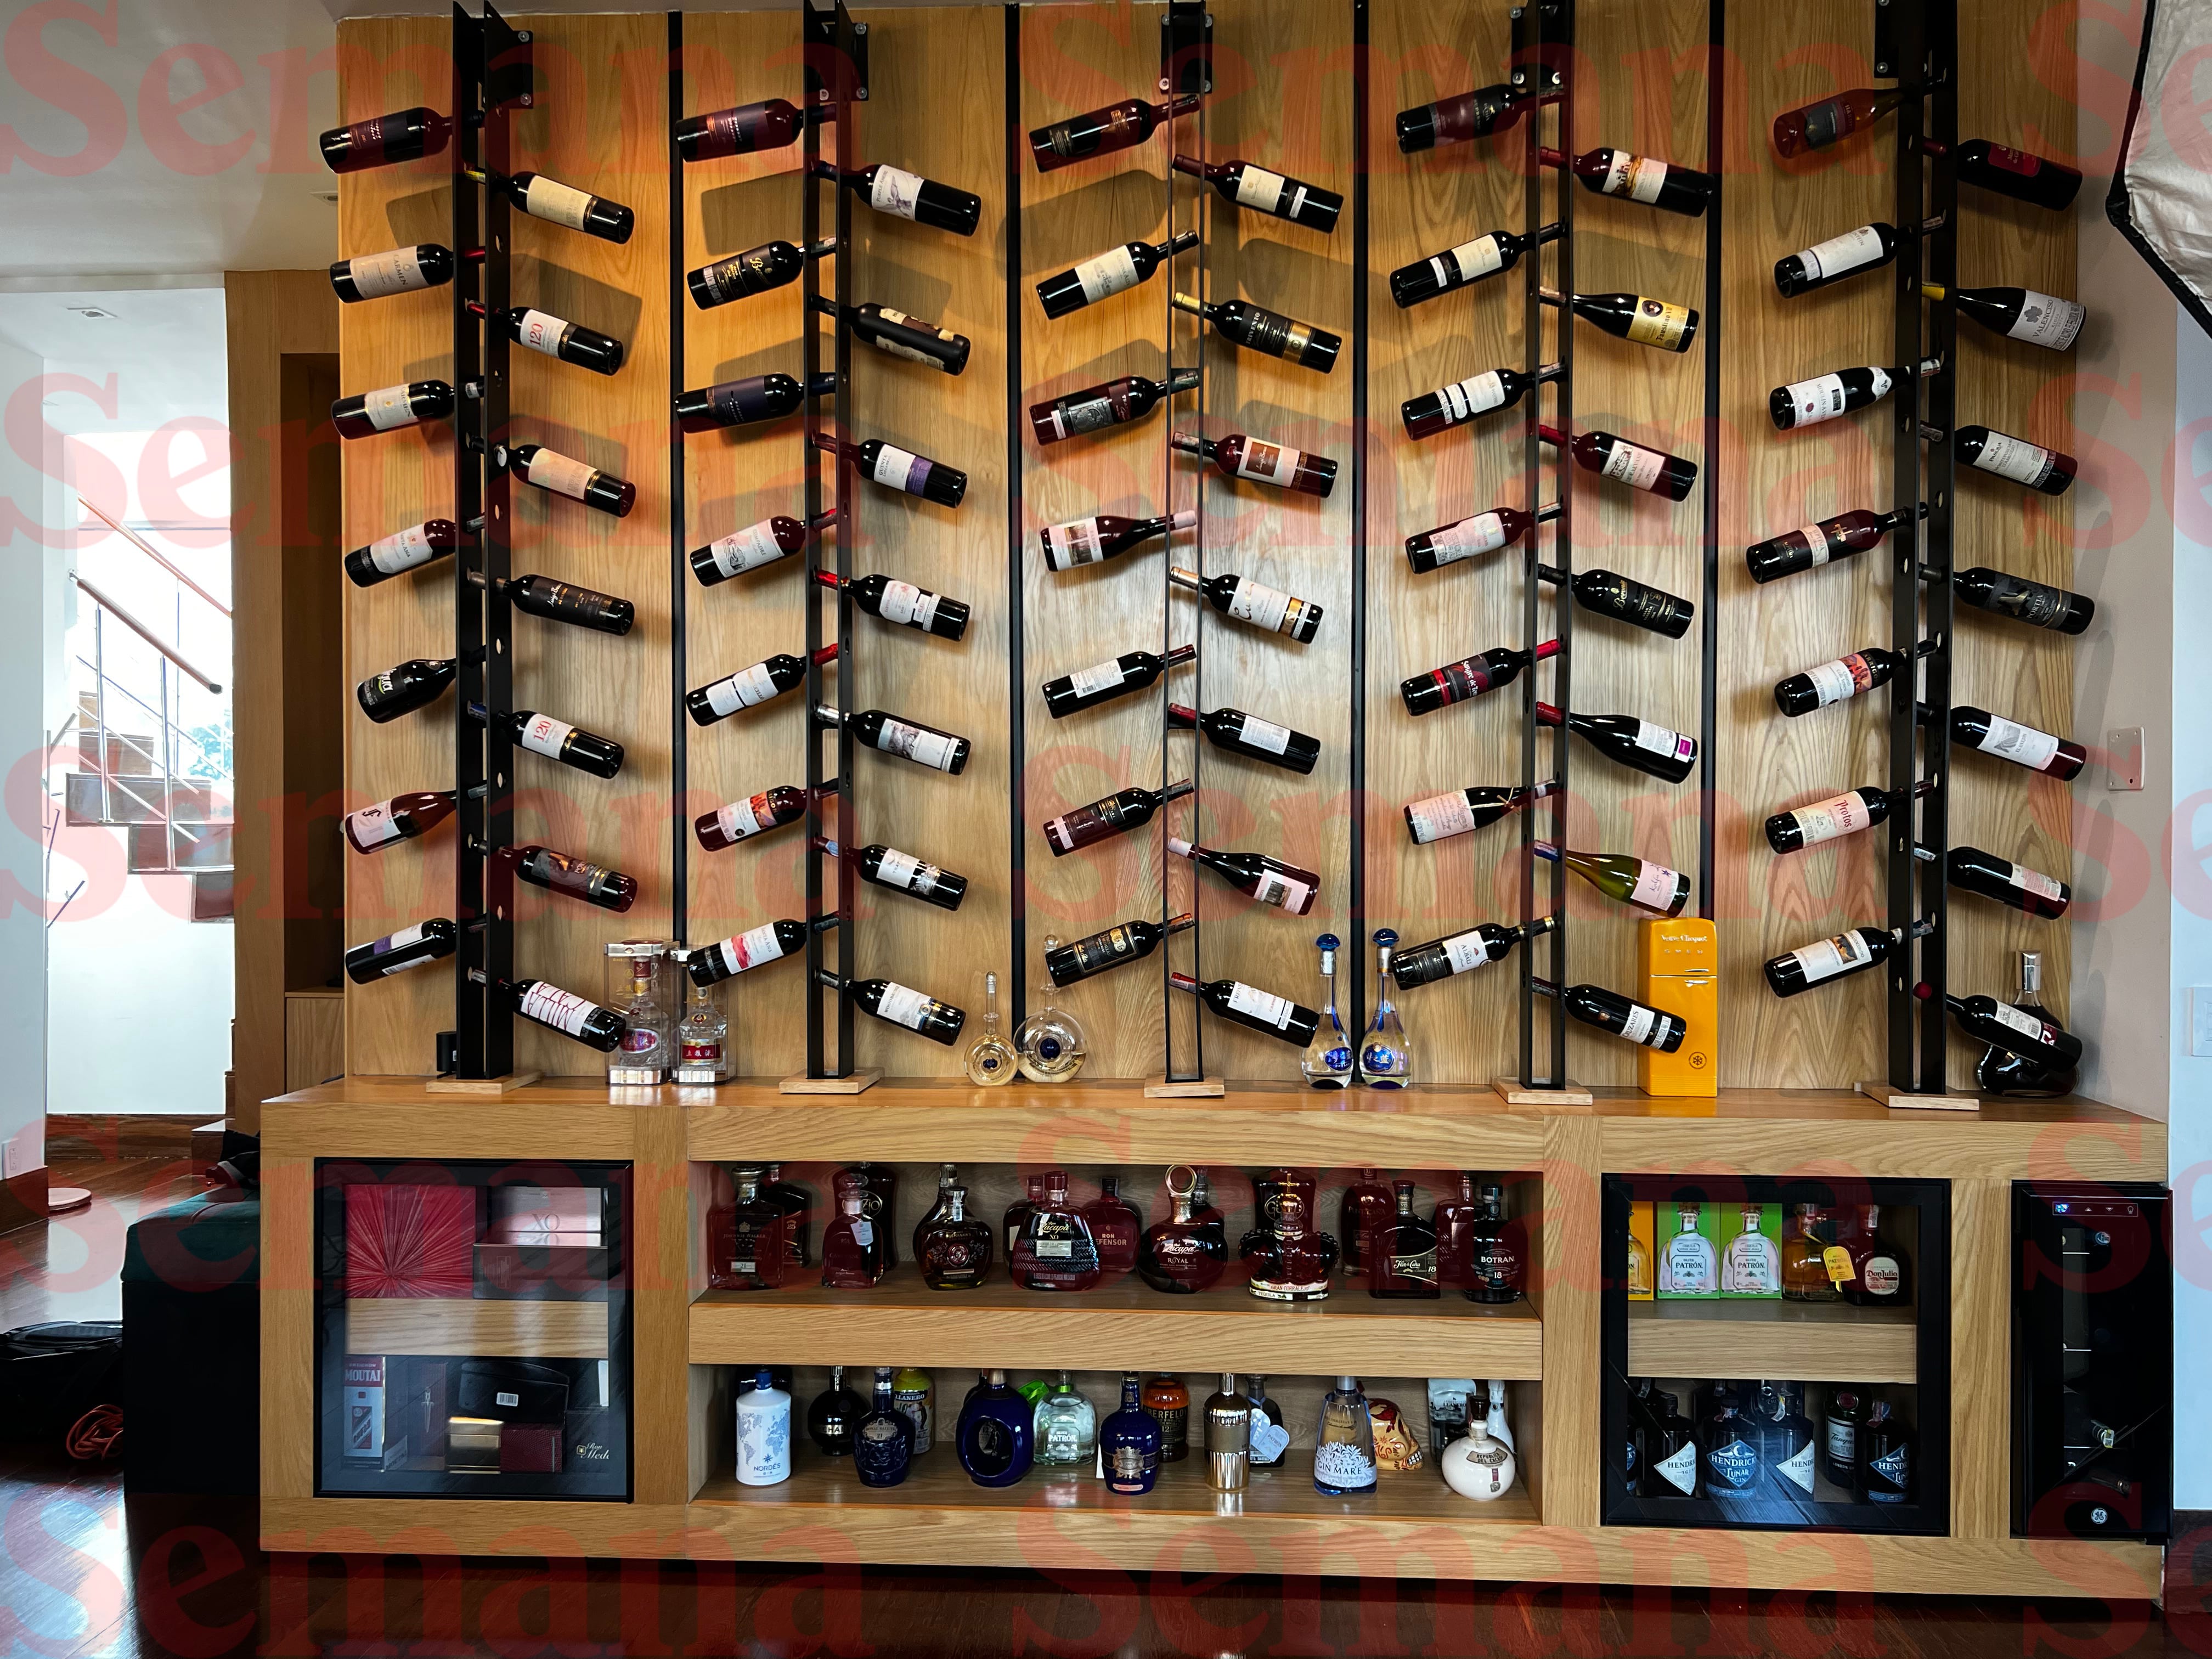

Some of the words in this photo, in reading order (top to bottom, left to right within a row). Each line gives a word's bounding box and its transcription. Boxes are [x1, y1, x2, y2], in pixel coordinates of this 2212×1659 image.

[874, 184, 884, 202] PURPLE
[392, 253, 408, 287] CARMEN
[1245, 310, 1261, 345] TRIVENTO
[1655, 313, 1671, 342] Faustino
[2032, 297, 2055, 339] VALENCISO
[526, 321, 547, 347] 120
[1259, 445, 1268, 459] Bosca
[1989, 440, 2003, 463] PASQUA
[877, 454, 889, 476] QUINTA
[1255, 458, 1266, 472] Luigi
[403, 545, 411, 558] ANA
[751, 528, 766, 557] COMPADRE
[1609, 578, 1632, 610] Beronia
[2025, 591, 2044, 620] PORTIA
[1460, 659, 1475, 680] Sangre
[1468, 678, 1476, 686] de
[1839, 678, 1848, 692] Senesi
[532, 718, 552, 743] 120
[1832, 800, 1854, 830] Protos
[764, 941, 773, 953] ANA
[1680, 934, 1707, 943] Clicquot
[1460, 943, 1472, 965] ALBALI
[883, 984, 900, 1014] WOODBRIDGE
[1622, 1009, 1639, 1039] CRUZARES
[532, 1213, 560, 1230] XO
[1037, 1222, 1070, 1233] Zacapa
[1162, 1244, 1196, 1254] Zacapa
[1393, 1260, 1407, 1268] Flor
[1481, 1256, 1514, 1264] BOTRAN
[345, 1369, 380, 1381] MOUTAI
[753, 1463, 780, 1471] NORDÉS
[1318, 1461, 1331, 1472] GIN
[1334, 1466, 1362, 1475] MARE
[1726, 1468, 1748, 1477] LUNAR
